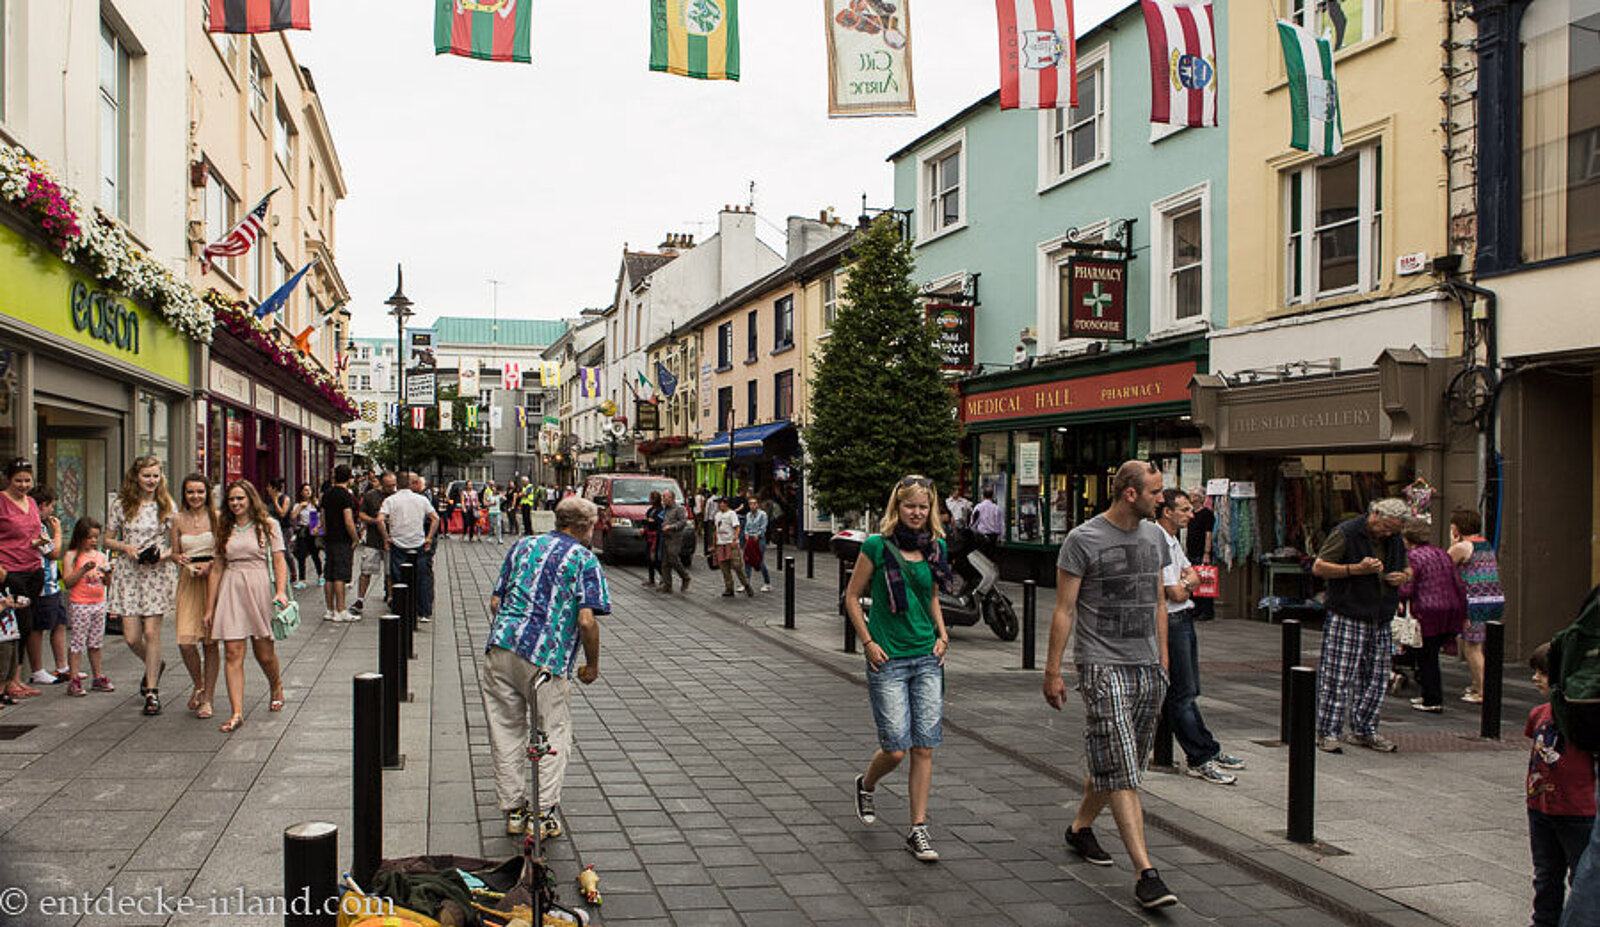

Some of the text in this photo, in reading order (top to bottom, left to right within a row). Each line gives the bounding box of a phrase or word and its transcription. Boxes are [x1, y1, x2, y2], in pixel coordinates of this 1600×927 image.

[1074, 266, 1122, 281] PHARMACY
[71, 280, 139, 354] eason
[967, 381, 1162, 416] MEDICAL HALL PHARMACY
[1261, 414, 1299, 430] SHOE
[1302, 409, 1374, 428] GALLERY
